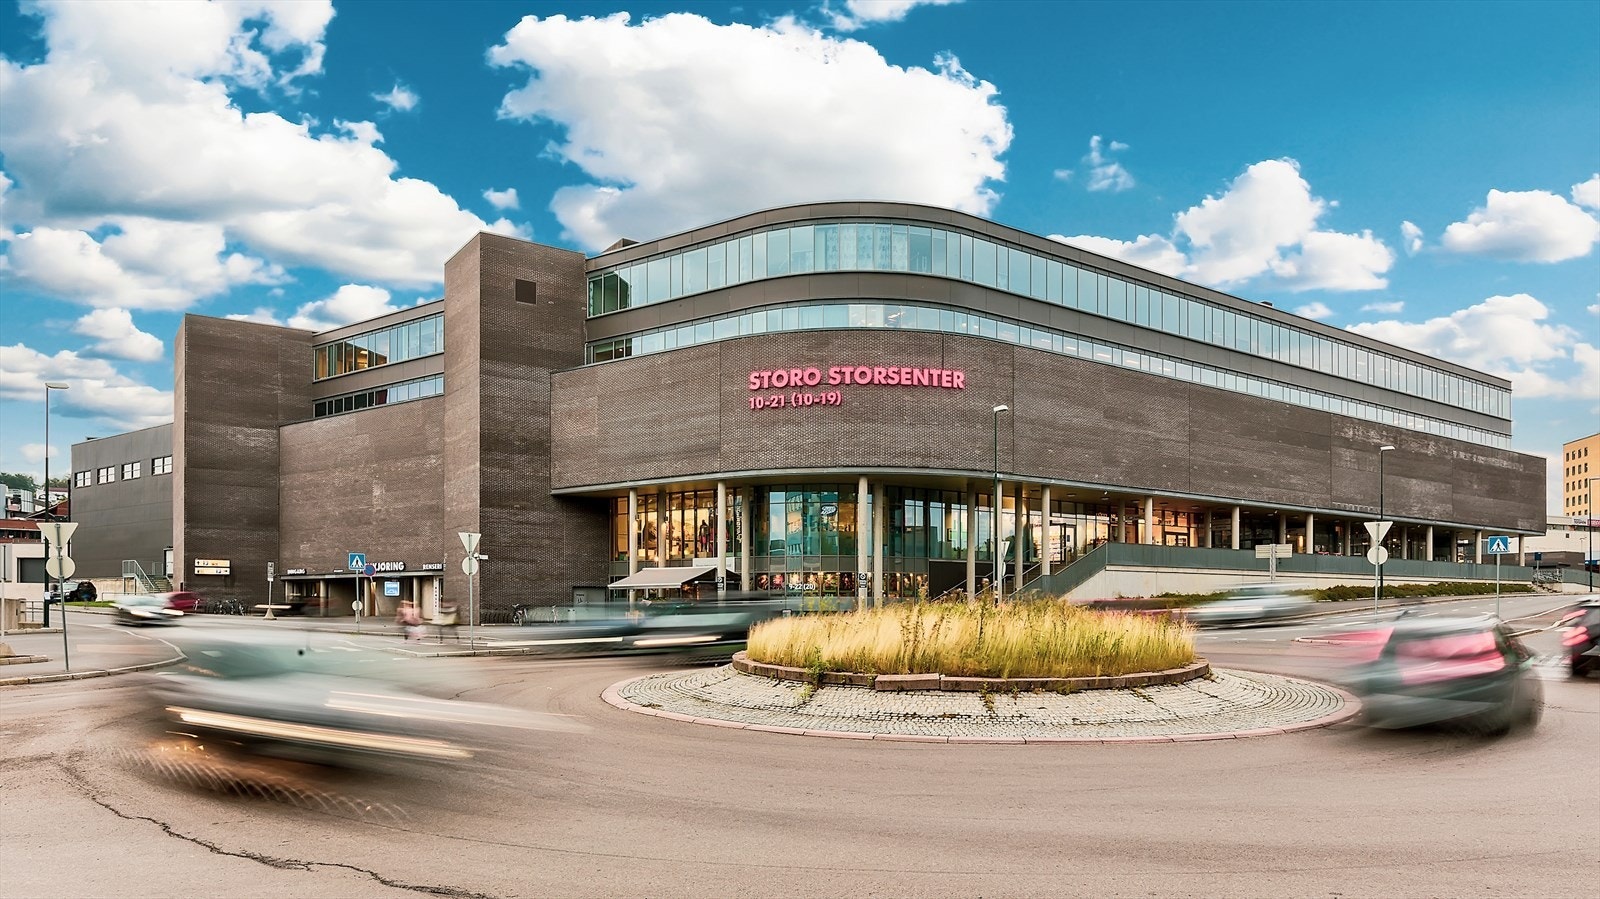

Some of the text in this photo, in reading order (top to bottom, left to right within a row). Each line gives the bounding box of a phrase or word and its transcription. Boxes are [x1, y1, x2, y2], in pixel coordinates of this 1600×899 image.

[749, 366, 965, 390] STORO STORSENTER
[749, 391, 842, 409] 10-21 (10-19)
